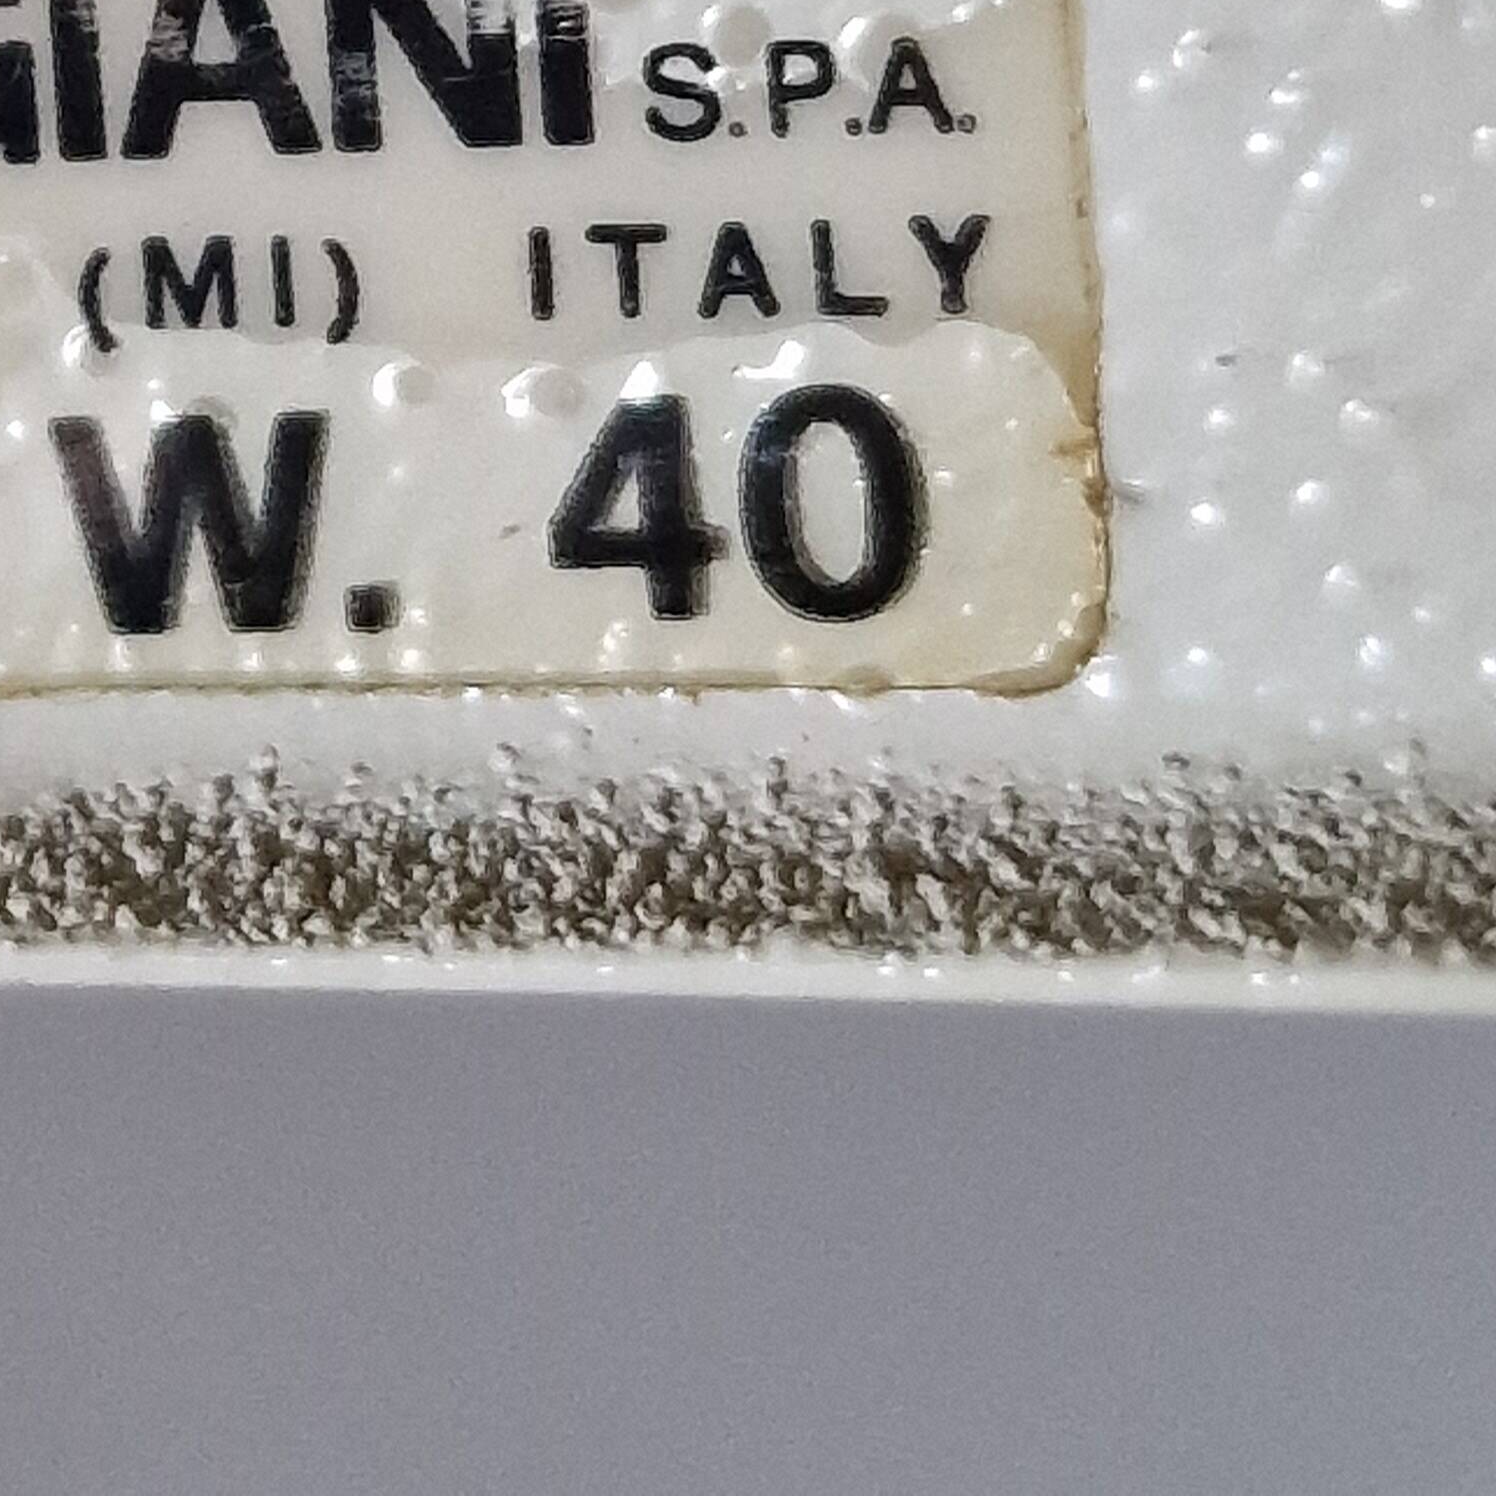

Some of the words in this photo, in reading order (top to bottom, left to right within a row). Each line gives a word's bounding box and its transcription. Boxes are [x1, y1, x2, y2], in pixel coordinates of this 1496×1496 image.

[642, 36, 976, 144] S.P.A.
[77, 235, 360, 354] (MI)
[527, 214, 992, 322] ITALY
[53, 406, 393, 636] W.
[551, 384, 928, 624] 40
